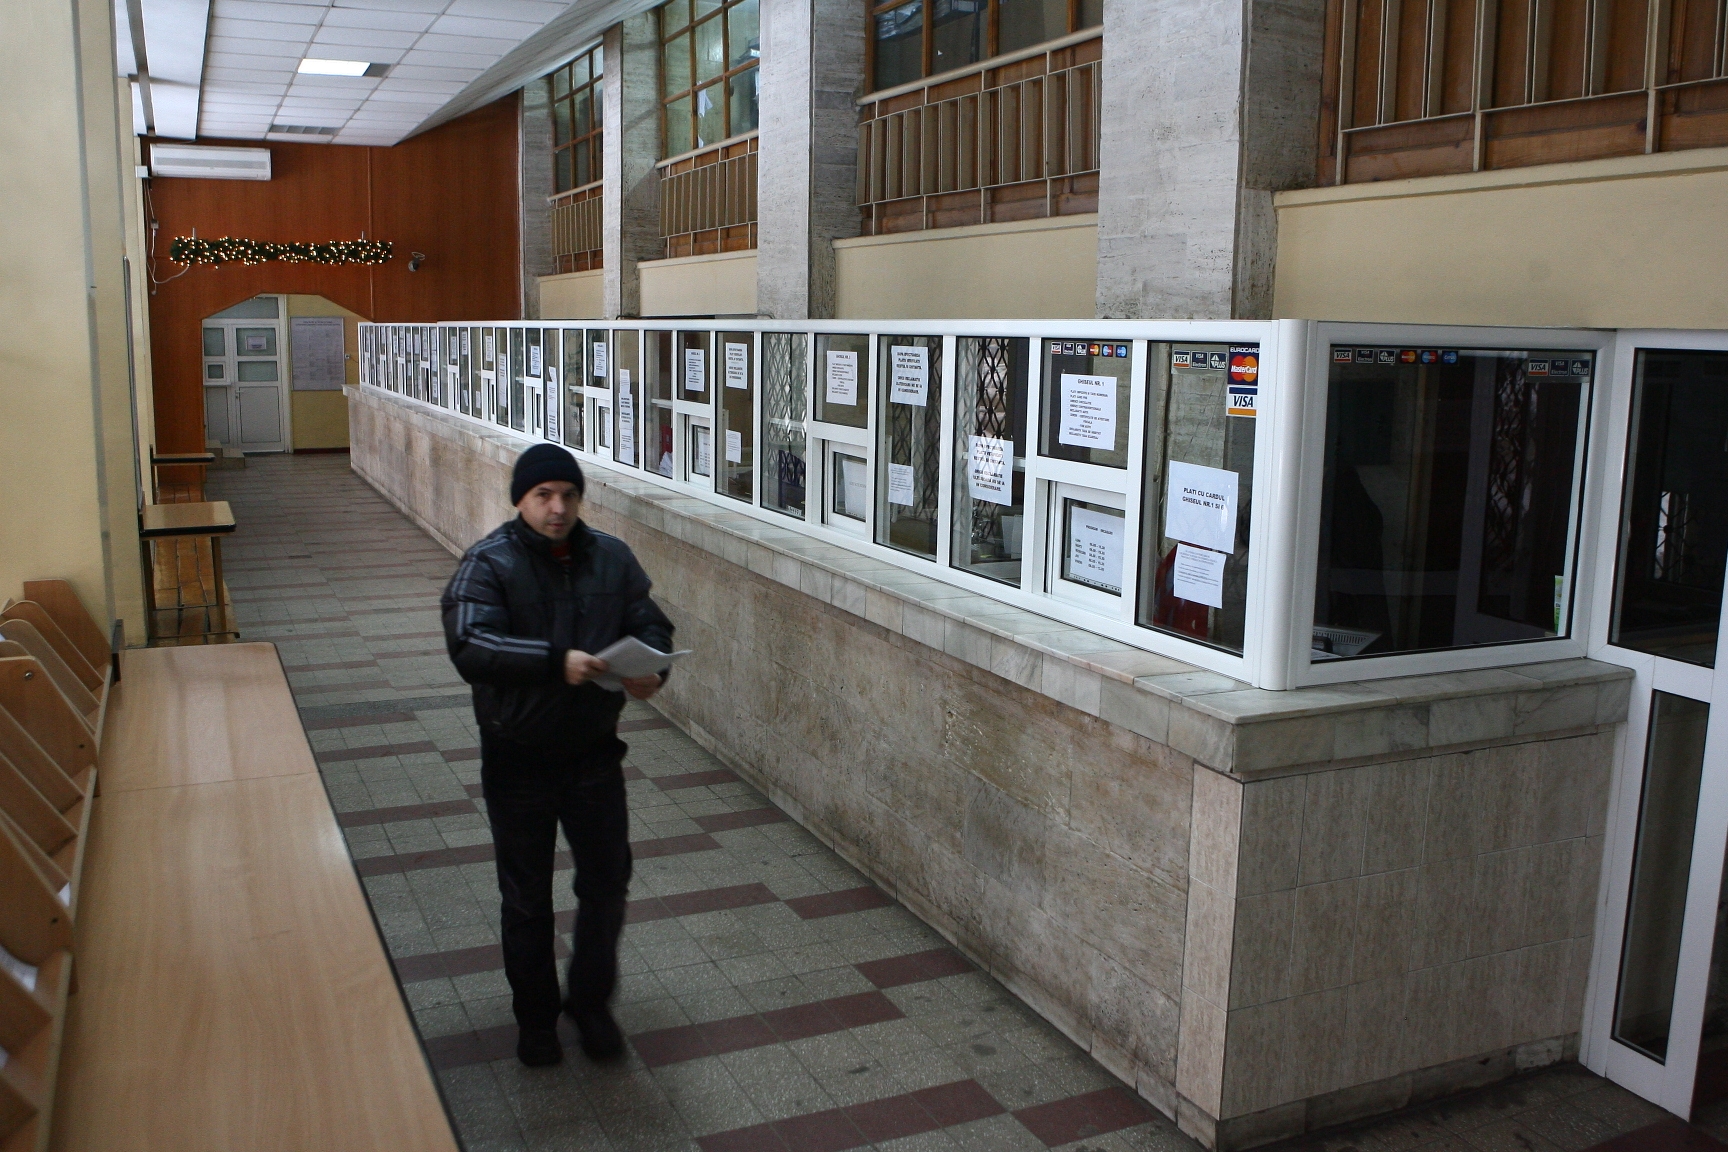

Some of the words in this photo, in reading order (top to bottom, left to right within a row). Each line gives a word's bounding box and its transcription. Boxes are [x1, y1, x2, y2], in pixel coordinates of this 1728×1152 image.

[1231, 365, 1257, 373] MasterCard
[1234, 396, 1254, 408] VISA
[1183, 487, 1197, 495] PLATI
[1206, 492, 1225, 502] CARDUL
[1182, 496, 1202, 506] GHISEUL
[1203, 500, 1214, 508] NR.1
